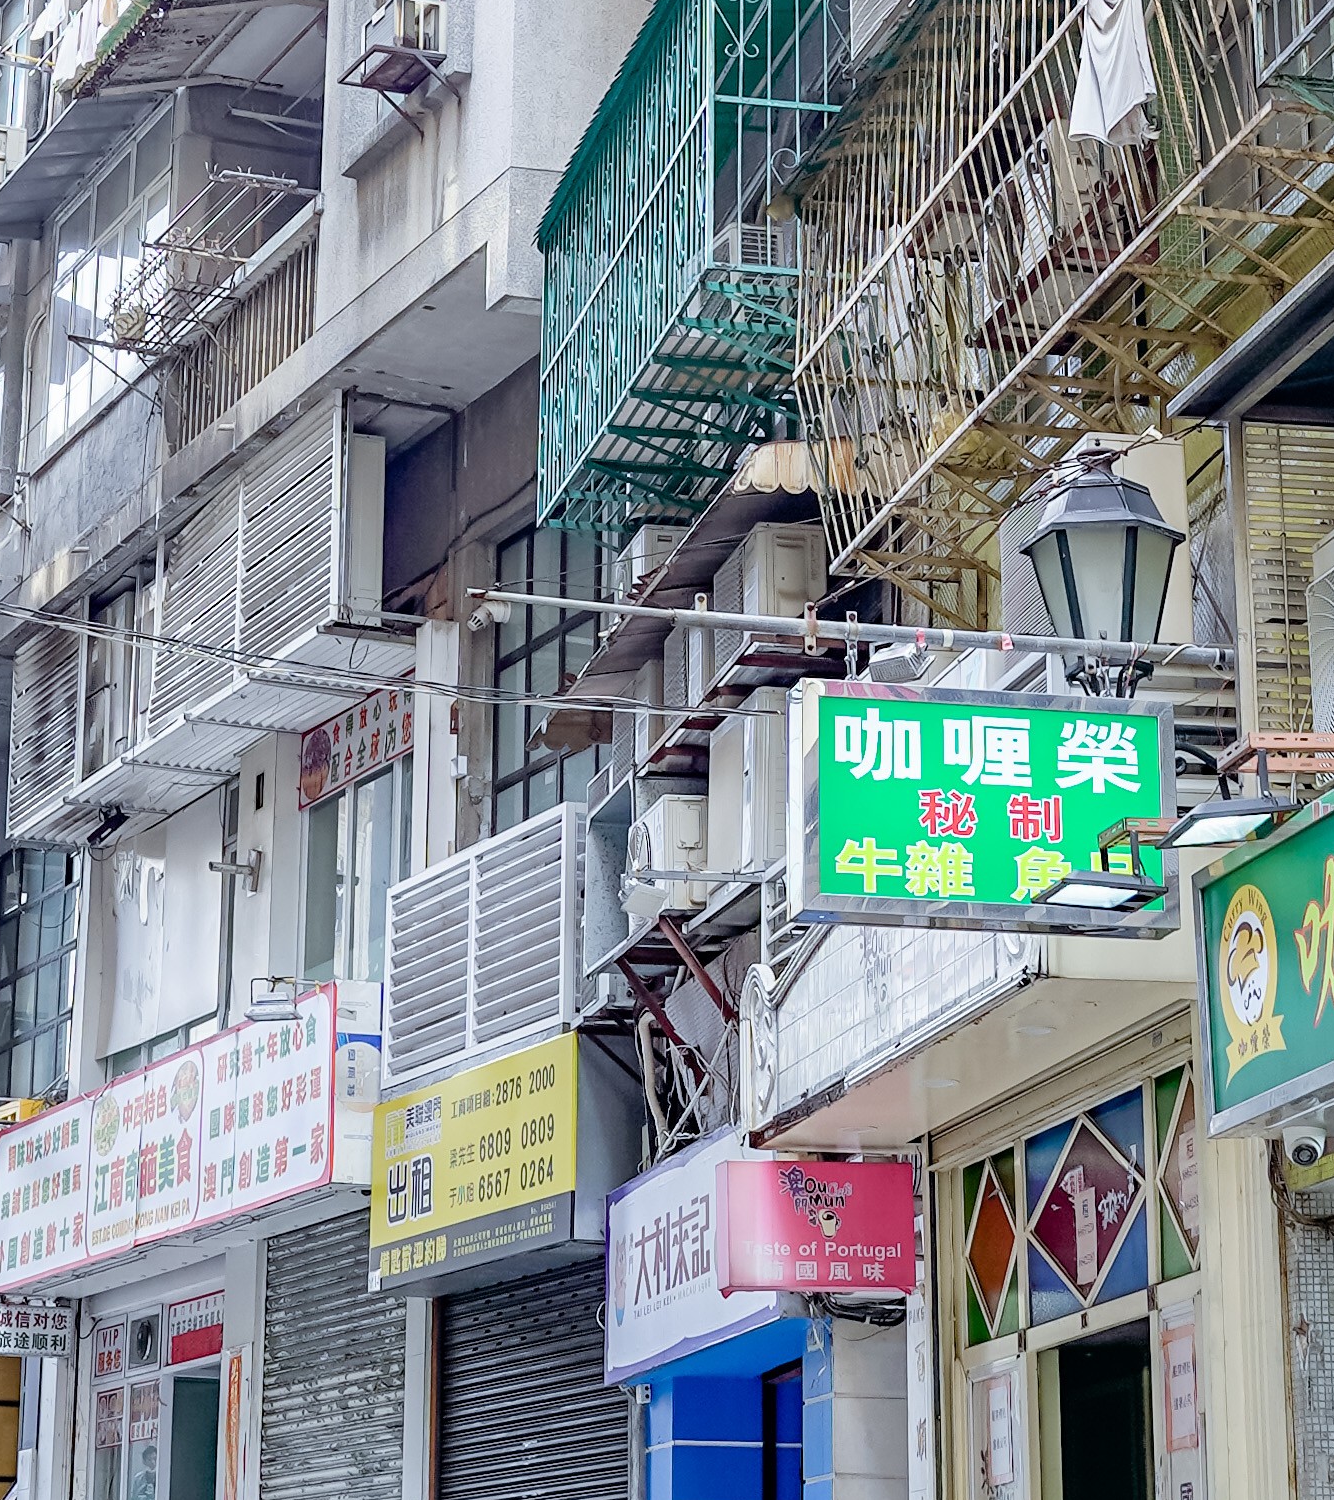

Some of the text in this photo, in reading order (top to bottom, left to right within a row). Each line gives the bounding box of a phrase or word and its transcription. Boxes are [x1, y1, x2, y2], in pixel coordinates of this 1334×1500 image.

[834, 708, 1141, 793] 咖喱榮
[918, 789, 1063, 841] 秘制
[835, 837, 975, 897] 牛雜
[1224, 897, 1243, 942] Curry
[496, 1075, 522, 1106] 2876
[529, 1064, 555, 1095] 2000
[479, 1127, 511, 1163] 6809
[521, 1113, 555, 1149] 0809
[93, 1127, 193, 1216] 江南奇葩美食
[388, 1156, 432, 1224] 出租
[478, 1168, 511, 1203] 6567
[520, 1154, 554, 1191] 0264
[804, 1178, 827, 1194] Ou
[746, 1241, 901, 1260] Taste of Portugal
[102, 1329, 119, 1347] VIP
